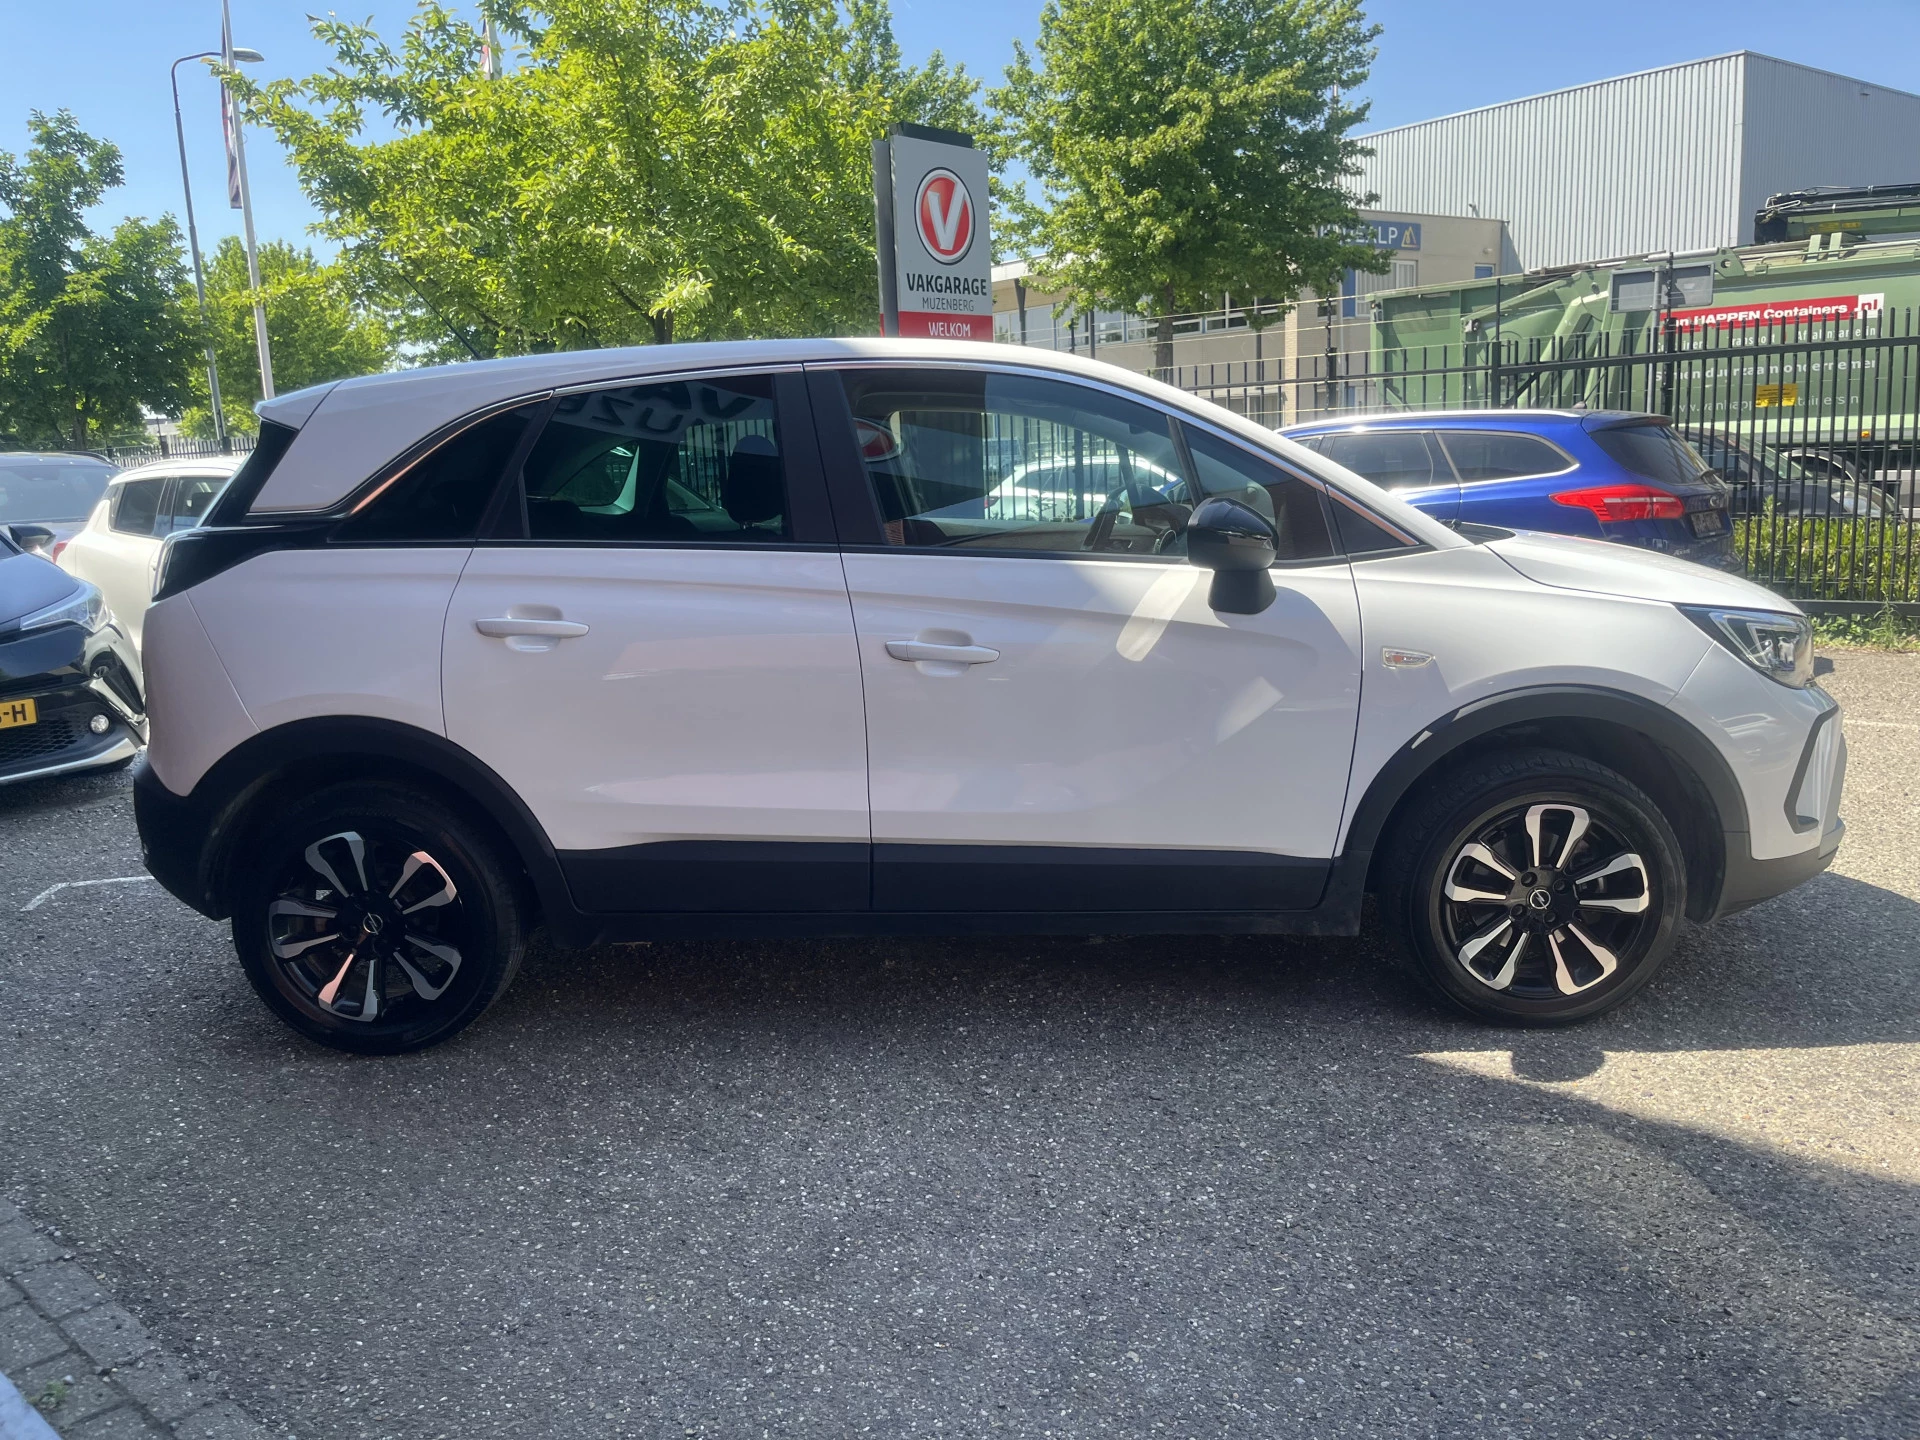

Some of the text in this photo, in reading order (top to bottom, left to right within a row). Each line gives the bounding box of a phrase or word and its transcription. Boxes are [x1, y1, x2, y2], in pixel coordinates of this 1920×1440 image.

[906, 272, 987, 296] VAKGARAGE
[922, 297, 975, 312] MUZENBERG
[1693, 311, 1761, 326] HAPPEN
[1763, 304, 1849, 321] Containers
[928, 321, 971, 337] WELKOM
